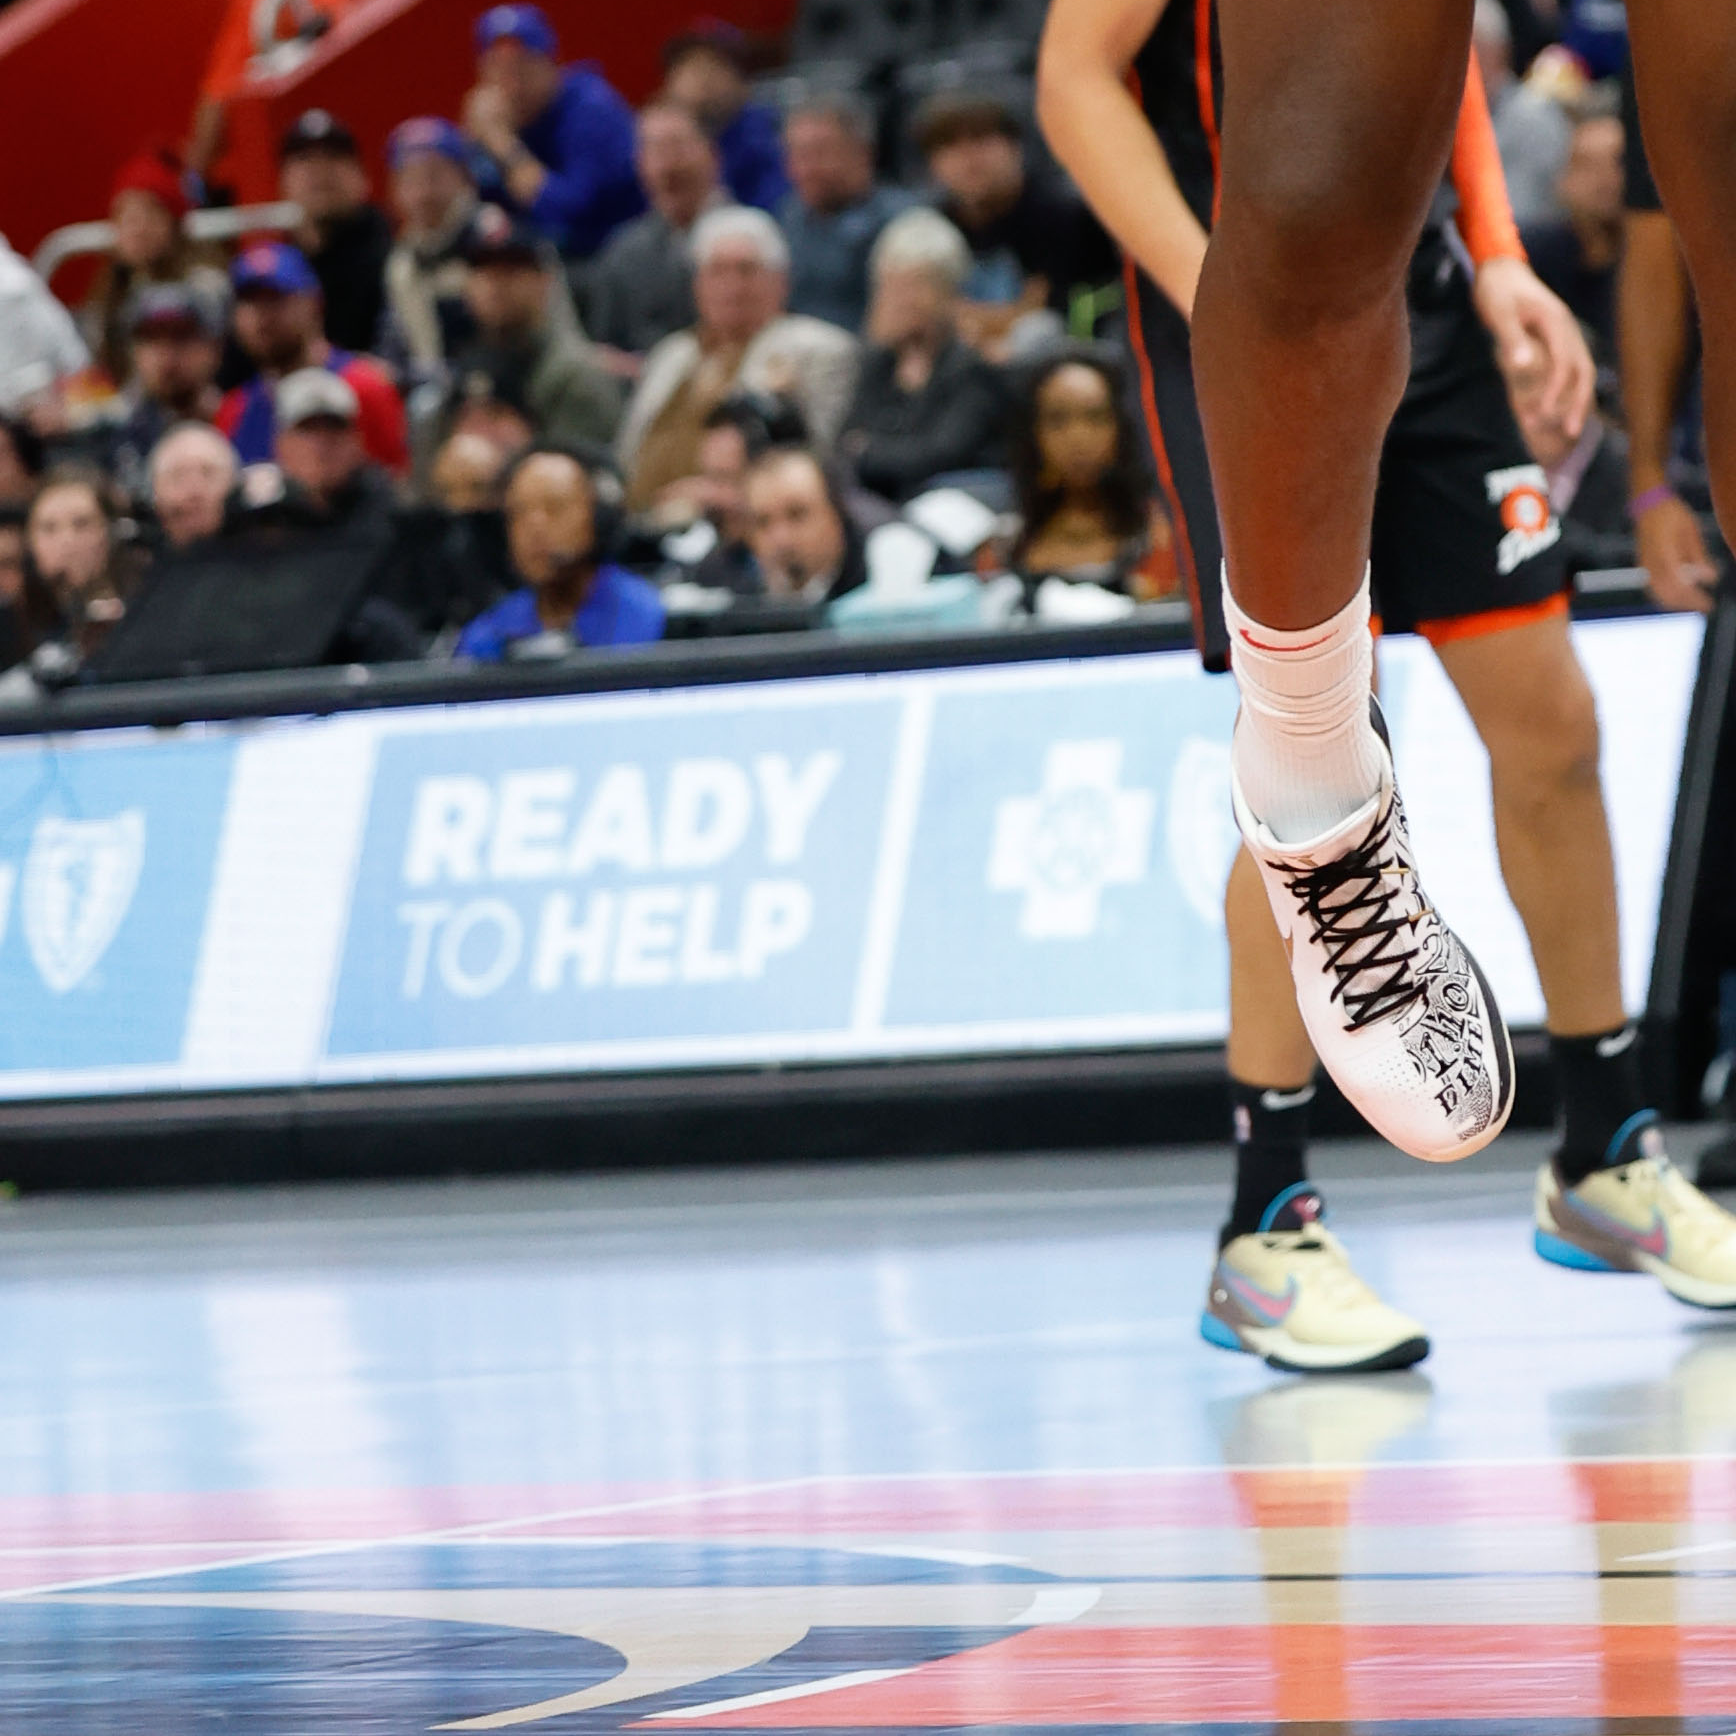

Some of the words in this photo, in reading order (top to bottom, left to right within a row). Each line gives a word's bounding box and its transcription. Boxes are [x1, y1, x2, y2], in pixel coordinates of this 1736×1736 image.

[402, 750, 845, 885] READY
[397, 897, 526, 1001] TO
[530, 879, 817, 994] HELP
